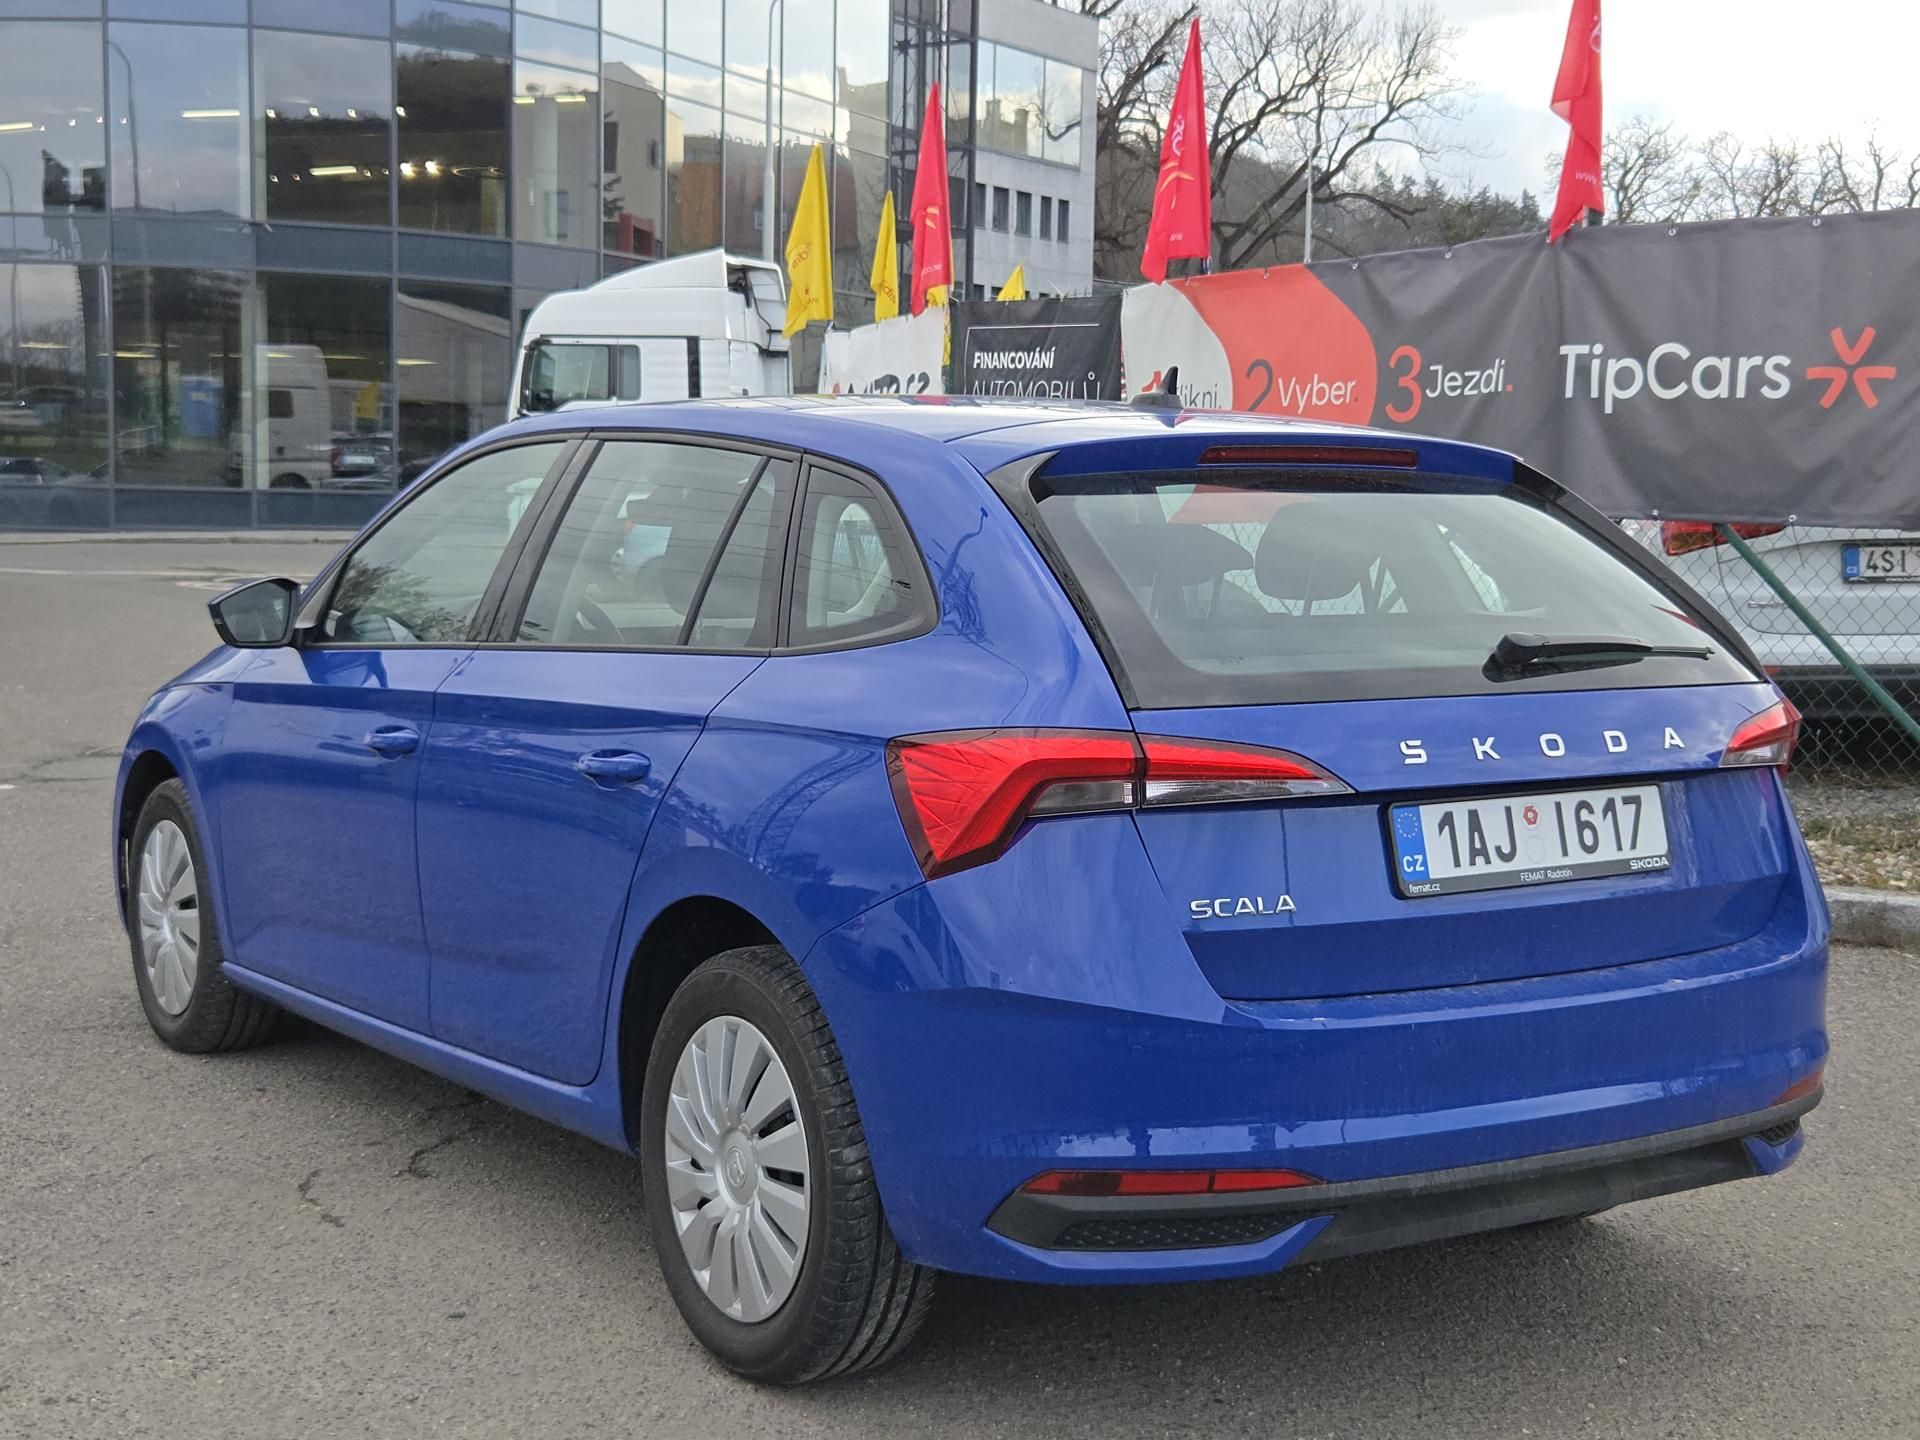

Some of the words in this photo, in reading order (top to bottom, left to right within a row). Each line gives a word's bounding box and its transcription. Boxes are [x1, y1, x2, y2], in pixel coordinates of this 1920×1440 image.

[973, 346, 1055, 369] FINANCOVÁNÍ
[1246, 358, 1273, 411] 2
[1278, 373, 1359, 414] Vyber.
[1384, 345, 1422, 423] 3
[1425, 358, 1513, 398] Jezdi.
[1559, 342, 1791, 414] TipCars
[1437, 805, 1517, 868] 1AJ
[1403, 854, 1425, 873] CZ
[1520, 870, 1545, 882] FEMAT
[1409, 883, 1441, 894] femat.cz
[1190, 894, 1297, 919] SCALA
